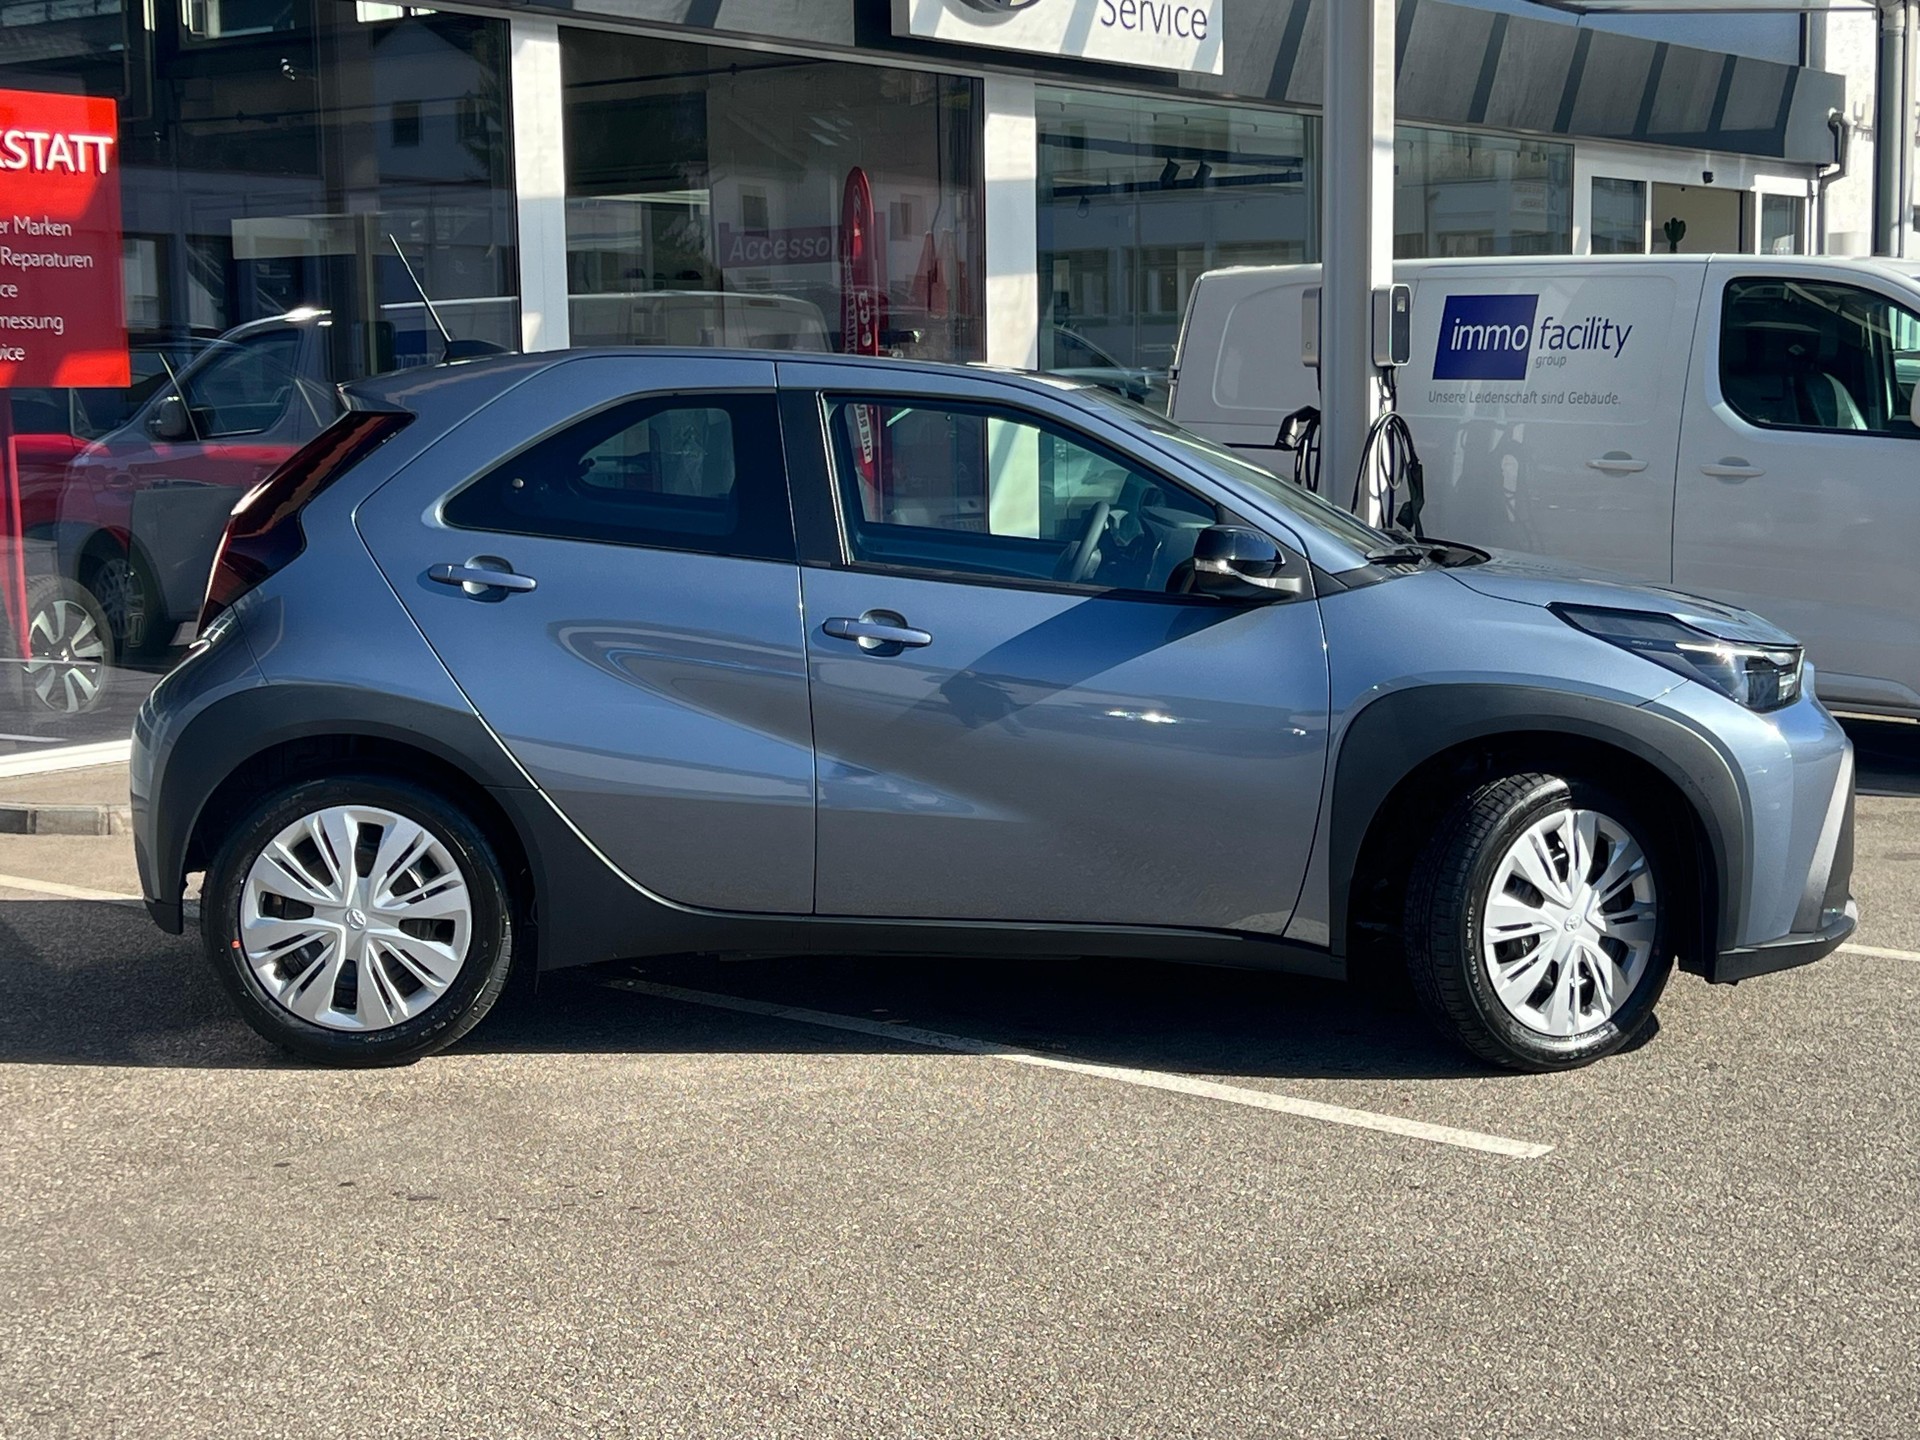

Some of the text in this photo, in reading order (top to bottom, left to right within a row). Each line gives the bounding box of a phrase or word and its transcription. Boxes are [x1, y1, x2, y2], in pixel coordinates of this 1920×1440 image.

[0, 130, 114, 174] STATT
[14, 215, 72, 237] Marken
[1, 246, 93, 271] Reparaturen
[1450, 316, 1633, 358] immo facility
[1535, 354, 1567, 368] group
[1428, 390, 1466, 404] Unsere
[1469, 390, 1538, 405] Leidenschaft
[1541, 391, 1564, 405] sind
